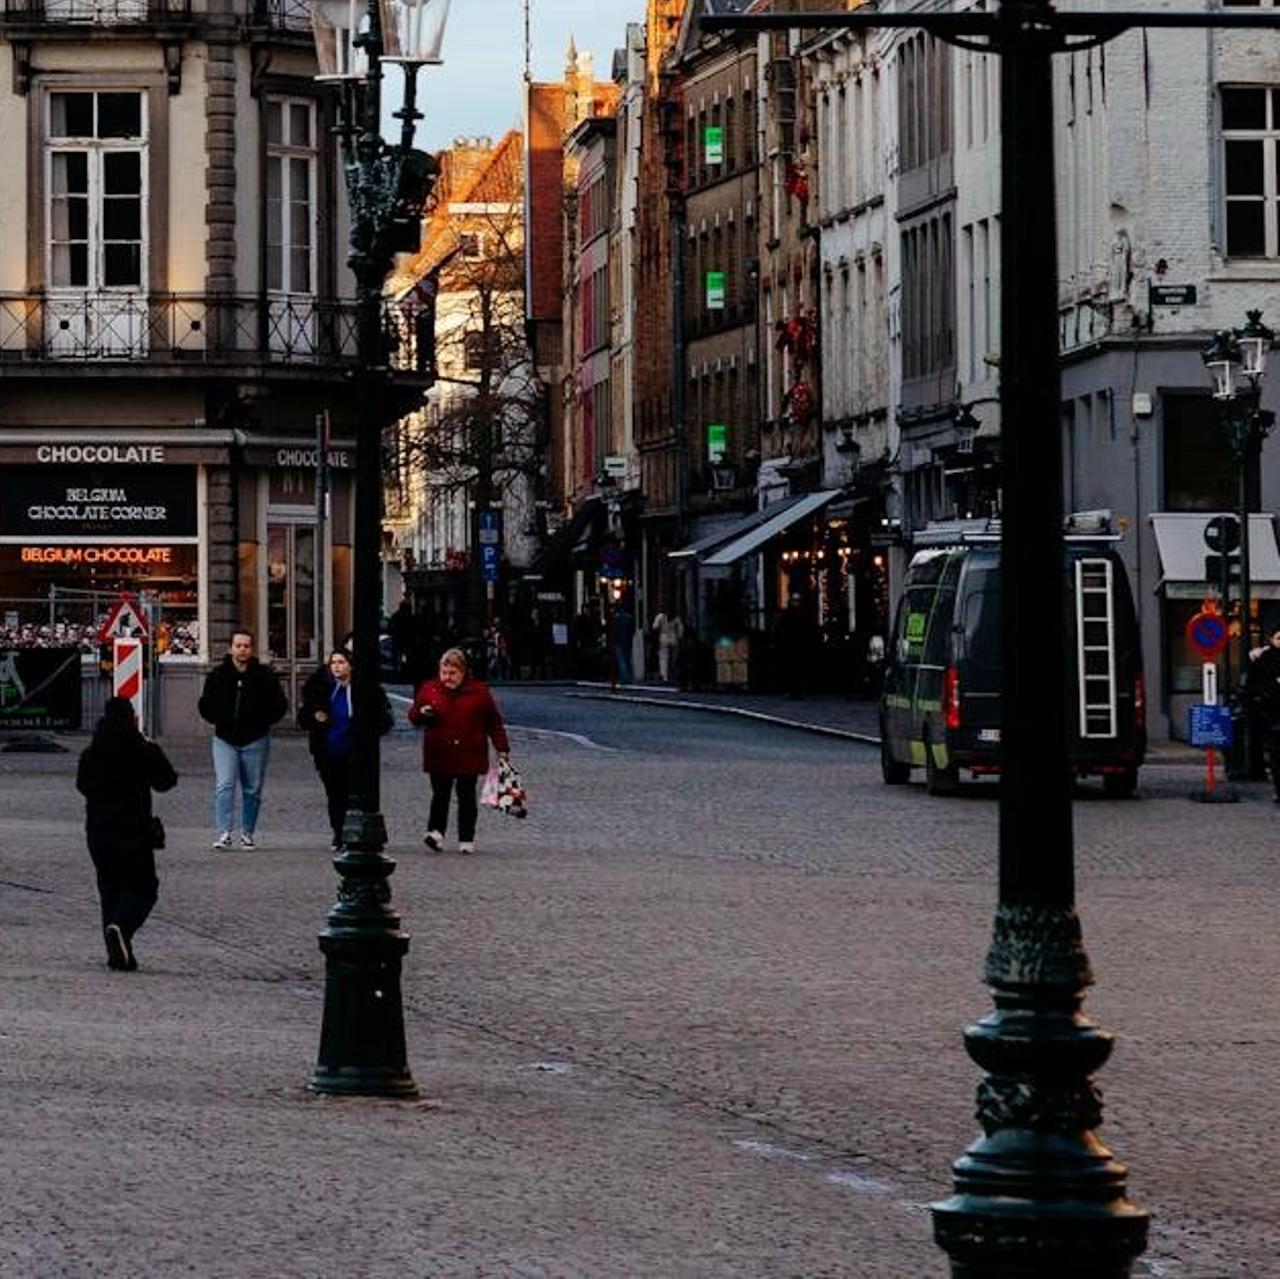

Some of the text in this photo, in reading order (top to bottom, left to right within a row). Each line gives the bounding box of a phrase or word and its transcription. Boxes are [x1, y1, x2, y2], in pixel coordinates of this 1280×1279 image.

[37, 446, 164, 463] CHOCOLATE
[277, 449, 349, 467] CHOCOATE
[66, 488, 127, 502] BELGIUM
[28, 506, 167, 520] CHOCOLATE CORNER
[21, 547, 171, 563] BELGIUM CHOCOLATE
